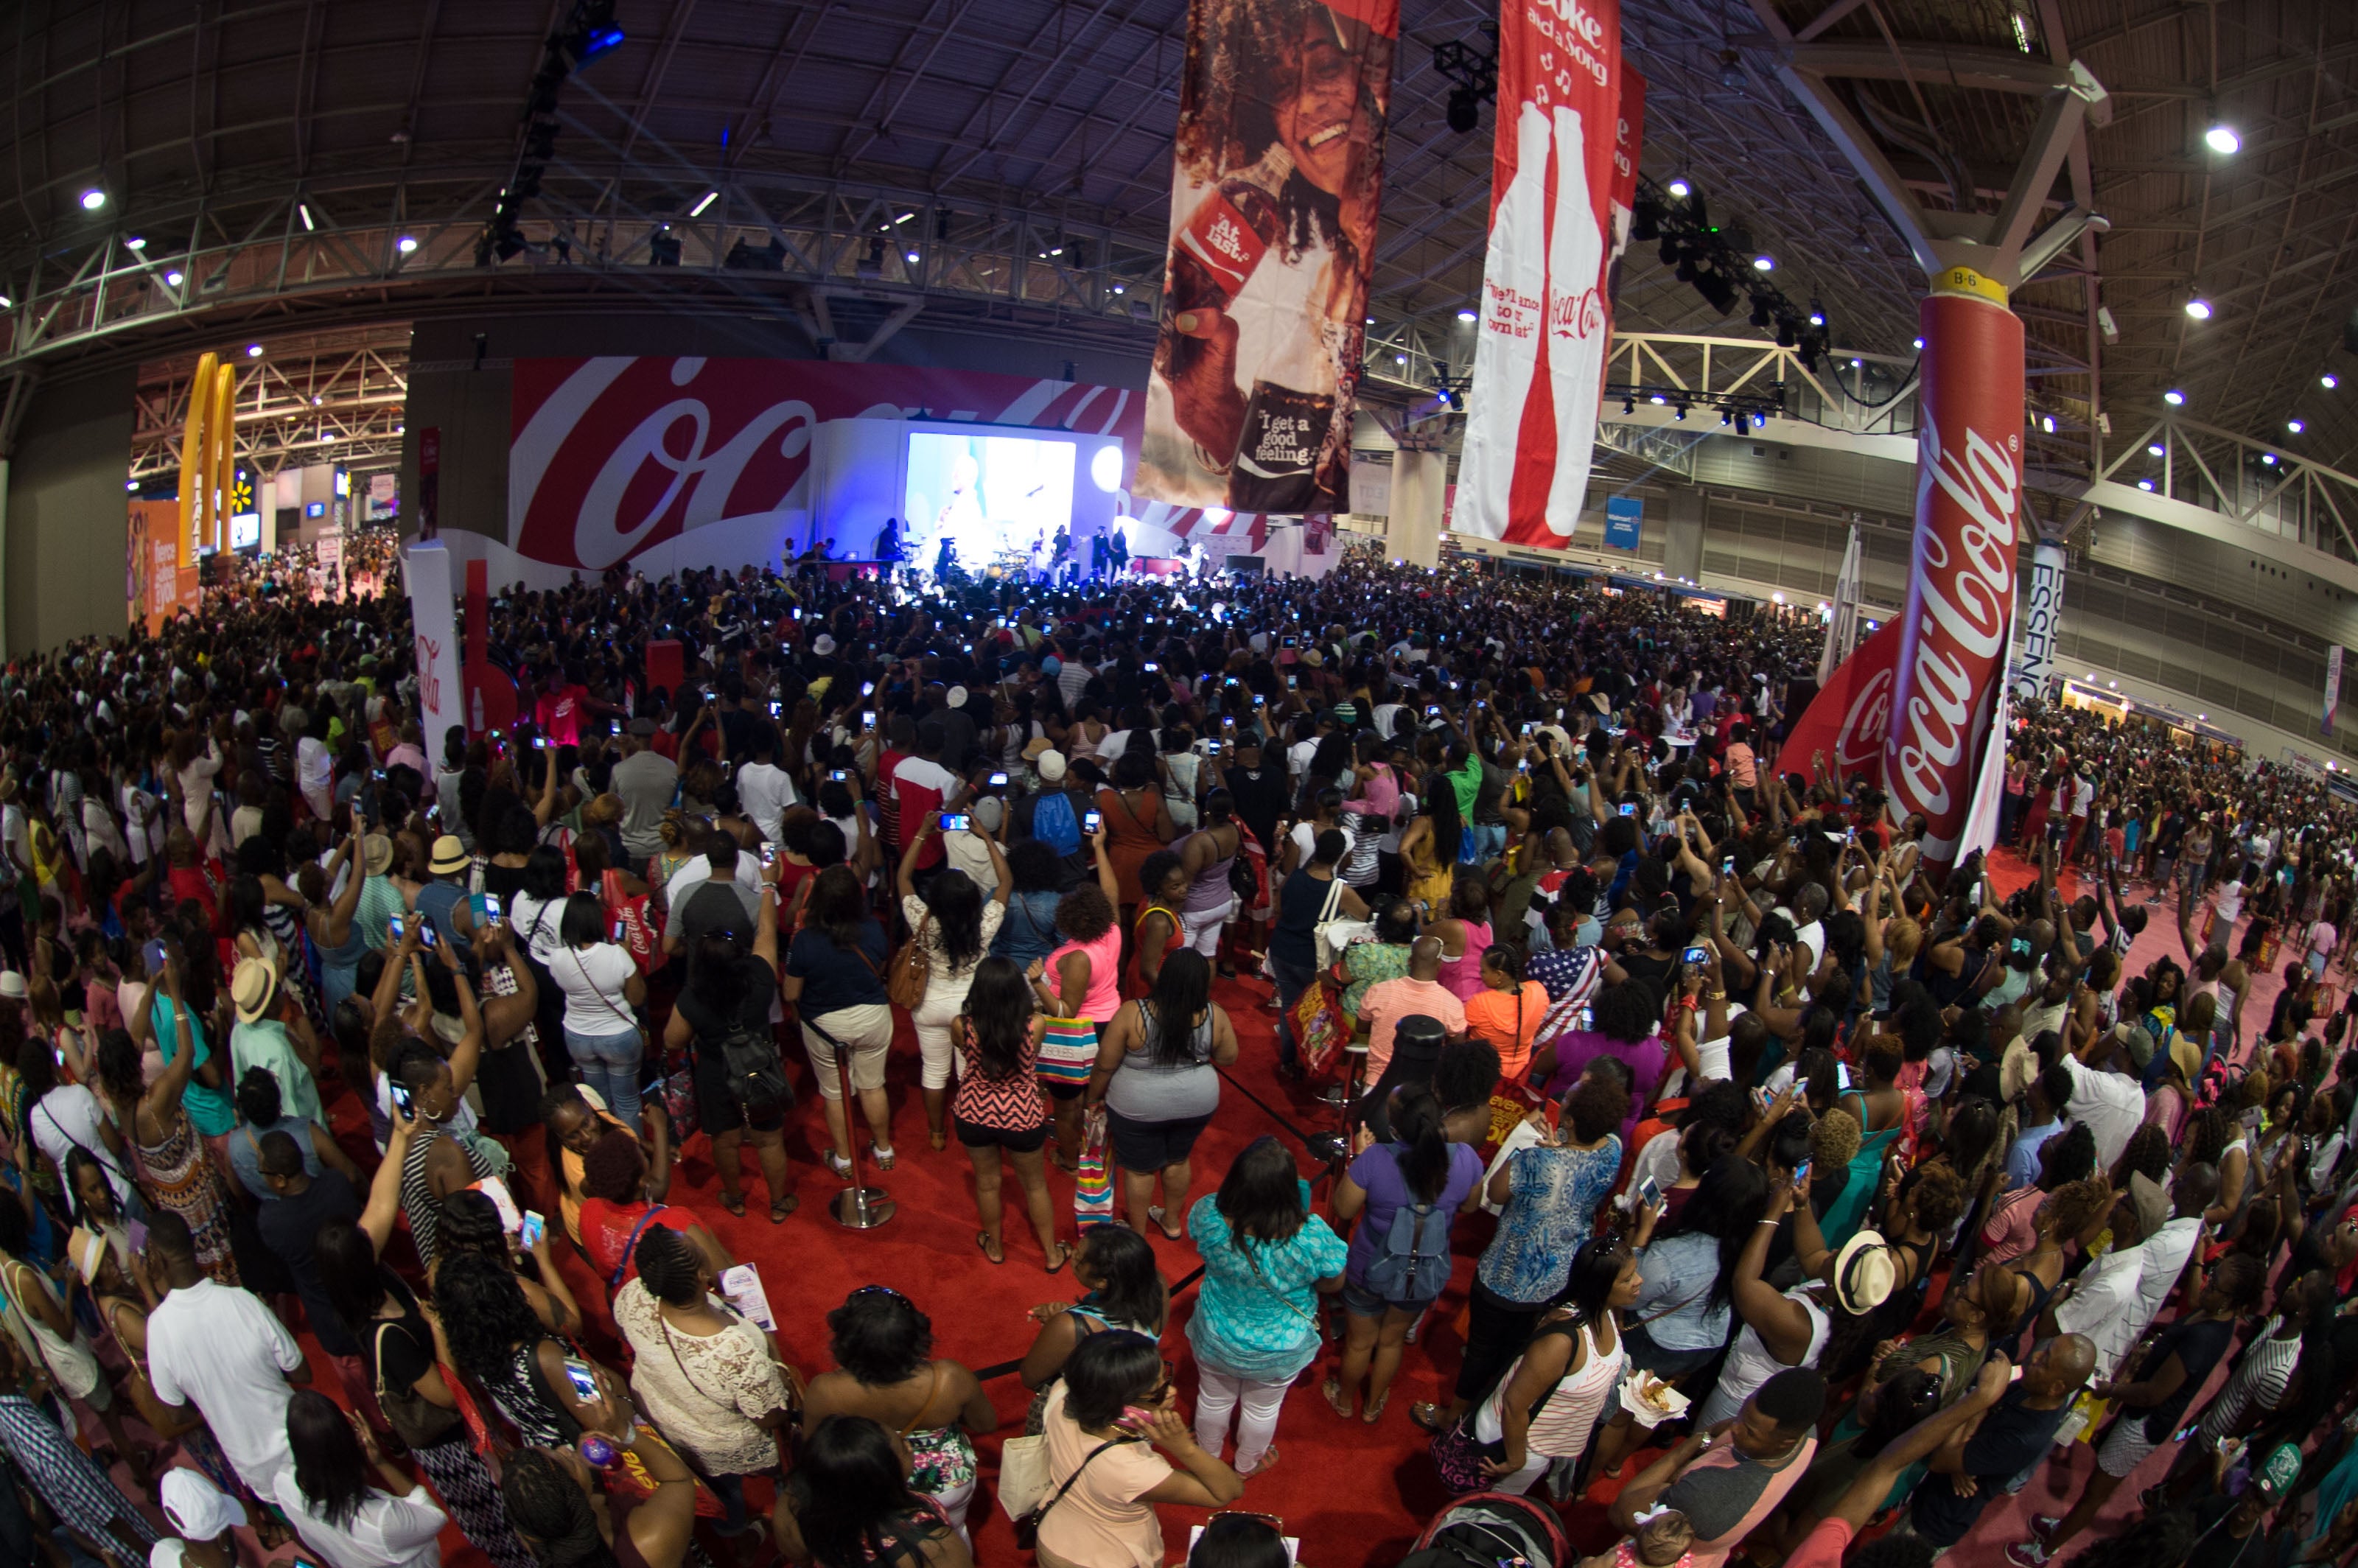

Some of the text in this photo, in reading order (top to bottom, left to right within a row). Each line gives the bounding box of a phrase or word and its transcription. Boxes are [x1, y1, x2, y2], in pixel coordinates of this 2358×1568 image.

[1564, 31, 1607, 87] Song
[1954, 272, 1976, 286] B-6
[1497, 304, 1512, 318] to
[1271, 416, 1295, 434] get
[1298, 419, 1310, 431] a
[1262, 430, 1298, 449] good
[1255, 446, 1313, 466] feeling.
[2018, 563, 2054, 701] ESSENC
